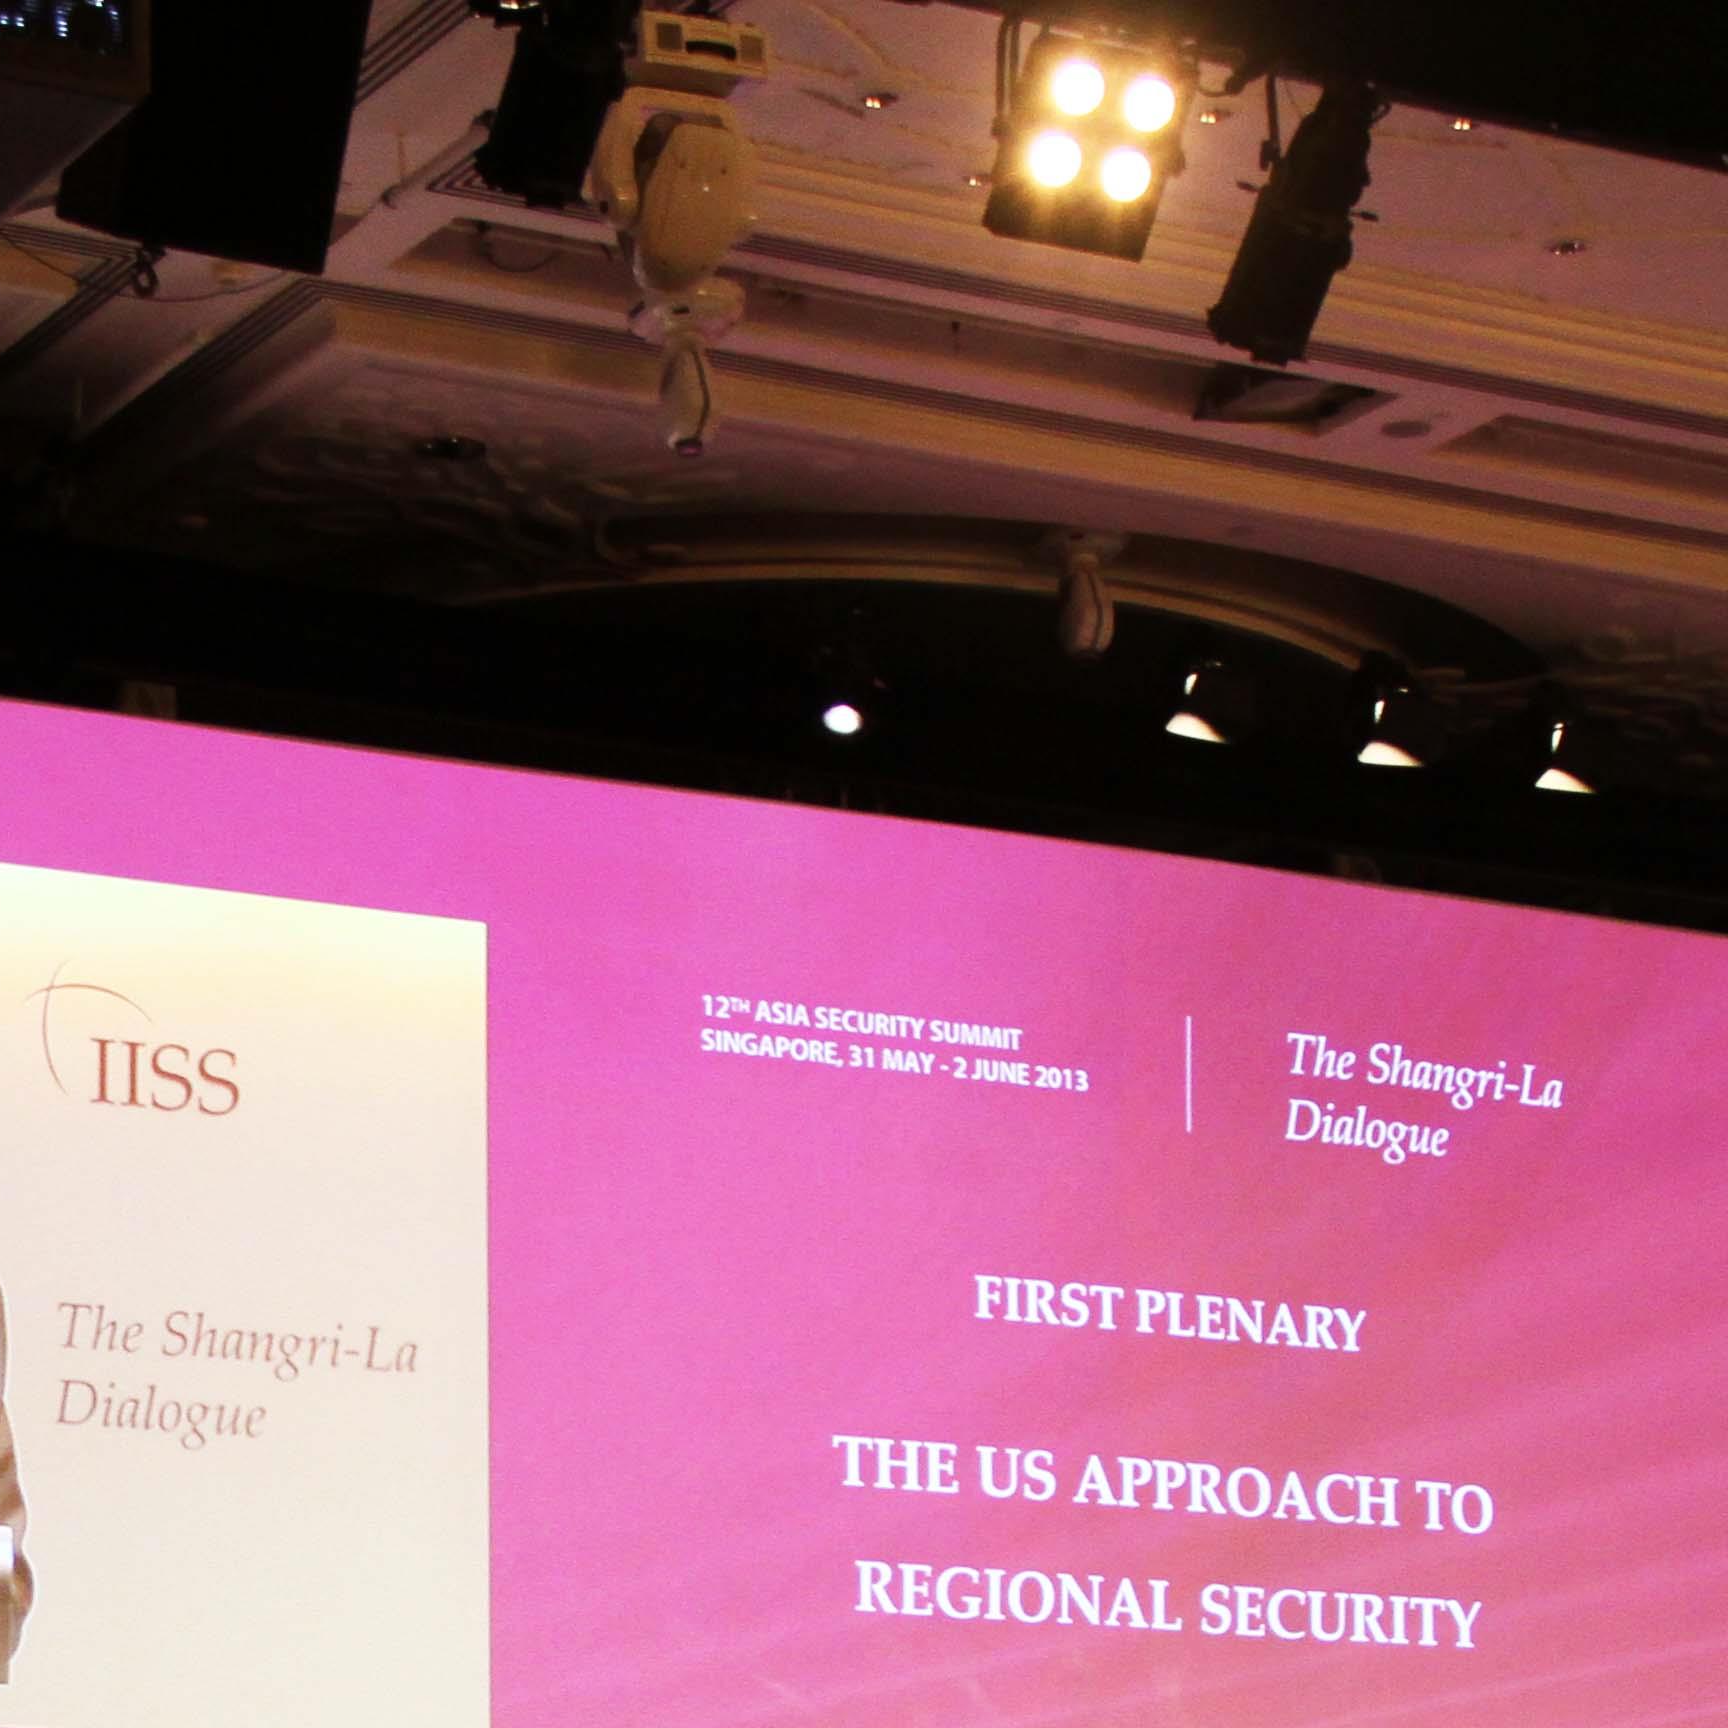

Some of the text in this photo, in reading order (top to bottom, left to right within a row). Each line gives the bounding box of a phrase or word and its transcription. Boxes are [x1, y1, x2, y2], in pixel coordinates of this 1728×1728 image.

[701, 1029, 844, 1068] SINGAPORE,
[848, 1044, 876, 1069] 31
[882, 1049, 935, 1075] MAY
[953, 1057, 968, 1079] 2
[971, 1059, 1031, 1087] JUNE
[1035, 1066, 1090, 1092] 2013
[755, 1000, 811, 1028] ASIA
[815, 1007, 925, 1040] SECURITY
[929, 1020, 1023, 1051] SUMMIT
[89, 1037, 240, 1116] IISS
[1286, 1032, 1564, 1111] The Shangri-La
[1284, 1100, 1450, 1165] Dialogue
[58, 1302, 419, 1383] The Shangri-La
[973, 1274, 1368, 1354] FIRST PLENARY
[56, 1379, 267, 1451] Dialogue
[832, 1434, 1495, 1536] THE US APPROACH TO
[854, 1559, 1483, 1648] REGIONAL SECURITY
